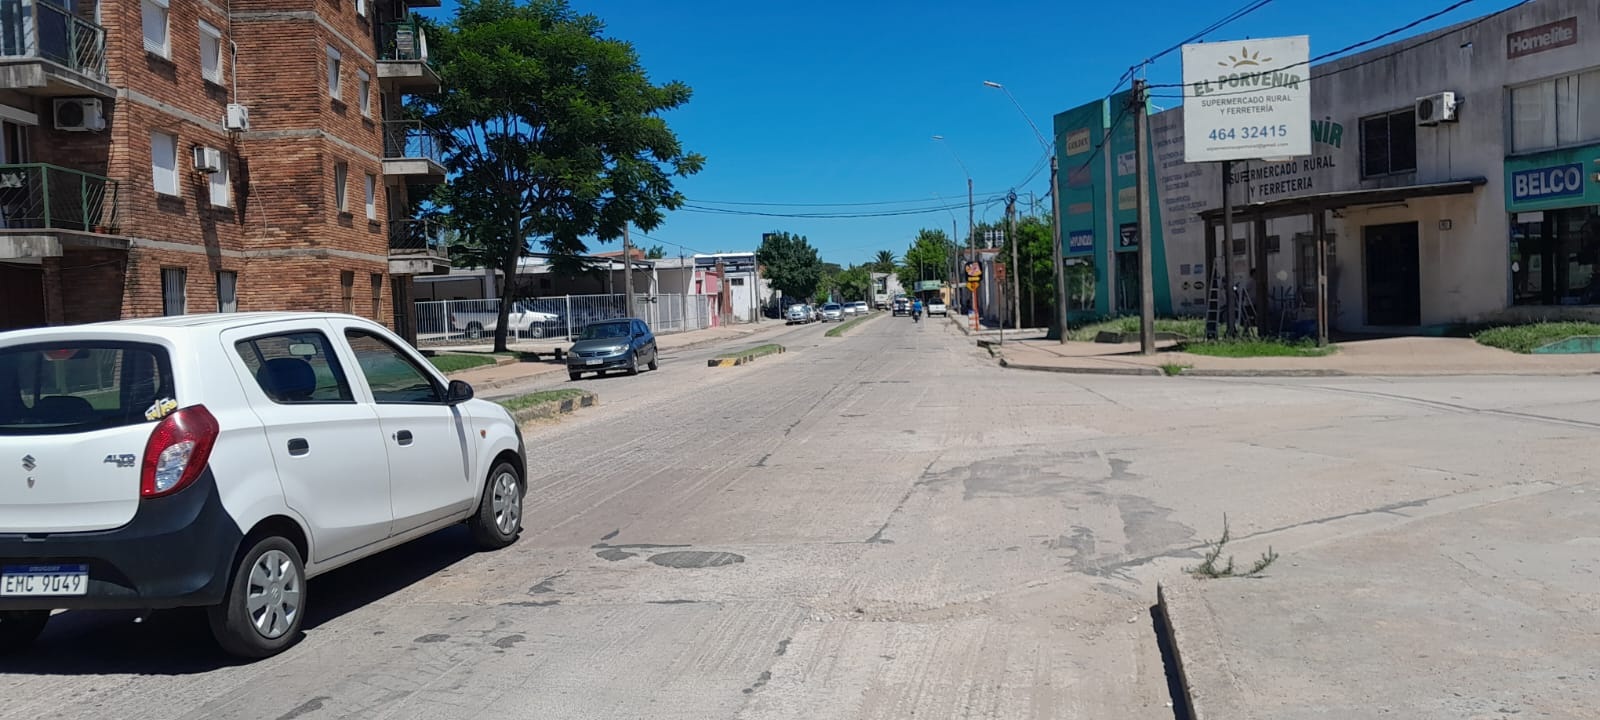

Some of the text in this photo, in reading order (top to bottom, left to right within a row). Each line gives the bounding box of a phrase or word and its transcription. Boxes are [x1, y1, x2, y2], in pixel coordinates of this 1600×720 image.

[1510, 26, 1574, 53] Homelite
[1193, 71, 1300, 97] EL PORVENIR
[1201, 94, 1291, 107] SUPERMERCADO RURAL
[1226, 104, 1274, 115] FERRETERÍA
[1208, 124, 1287, 140] 464 32415
[1230, 155, 1336, 184] SUPERMERCADO RURAL
[1249, 176, 1313, 198] Y FERRETERIA
[1515, 167, 1581, 197] BELCO
[103, 454, 136, 464] ALTO
[6, 573, 81, 592] EMC 9049
